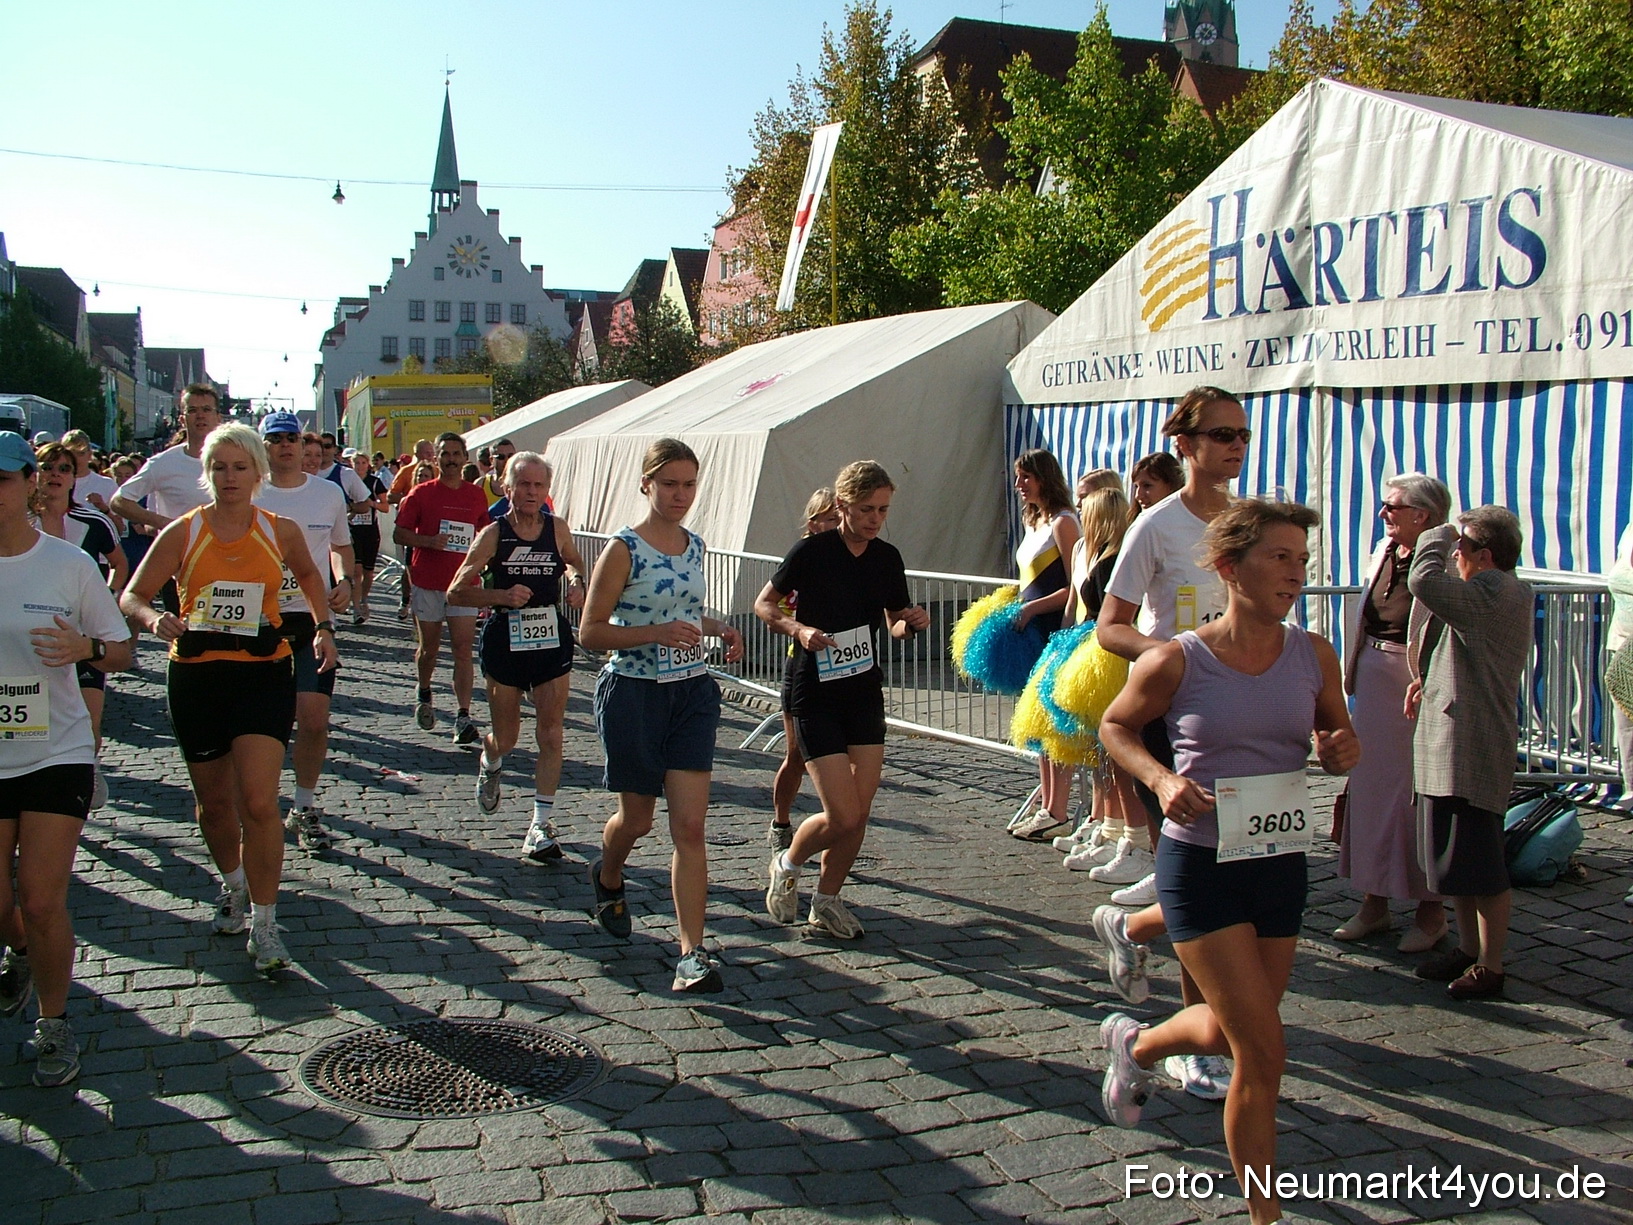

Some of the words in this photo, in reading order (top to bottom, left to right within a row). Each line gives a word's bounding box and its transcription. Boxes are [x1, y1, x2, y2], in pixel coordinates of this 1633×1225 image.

[1202, 185, 1547, 321] HÄRTEIS
[1042, 351, 1143, 387] GETRÄNKE
[1156, 343, 1224, 375] WEINE
[1474, 316, 1563, 355] TEL.
[448, 535, 470, 546] 3361
[507, 566, 520, 575] SC
[522, 566, 541, 575] Roth
[542, 566, 553, 575] 52
[212, 587, 244, 598] Annett
[197, 601, 205, 609] D
[212, 604, 245, 621] 739
[521, 611, 547, 621] Herbert
[512, 625, 518, 633] D
[523, 625, 554, 639] 3291
[660, 647, 667, 657] D
[673, 644, 701, 665] 3390
[833, 641, 870, 665] 2908
[0, 704, 28, 723] 35
[1248, 809, 1306, 836] 3603
